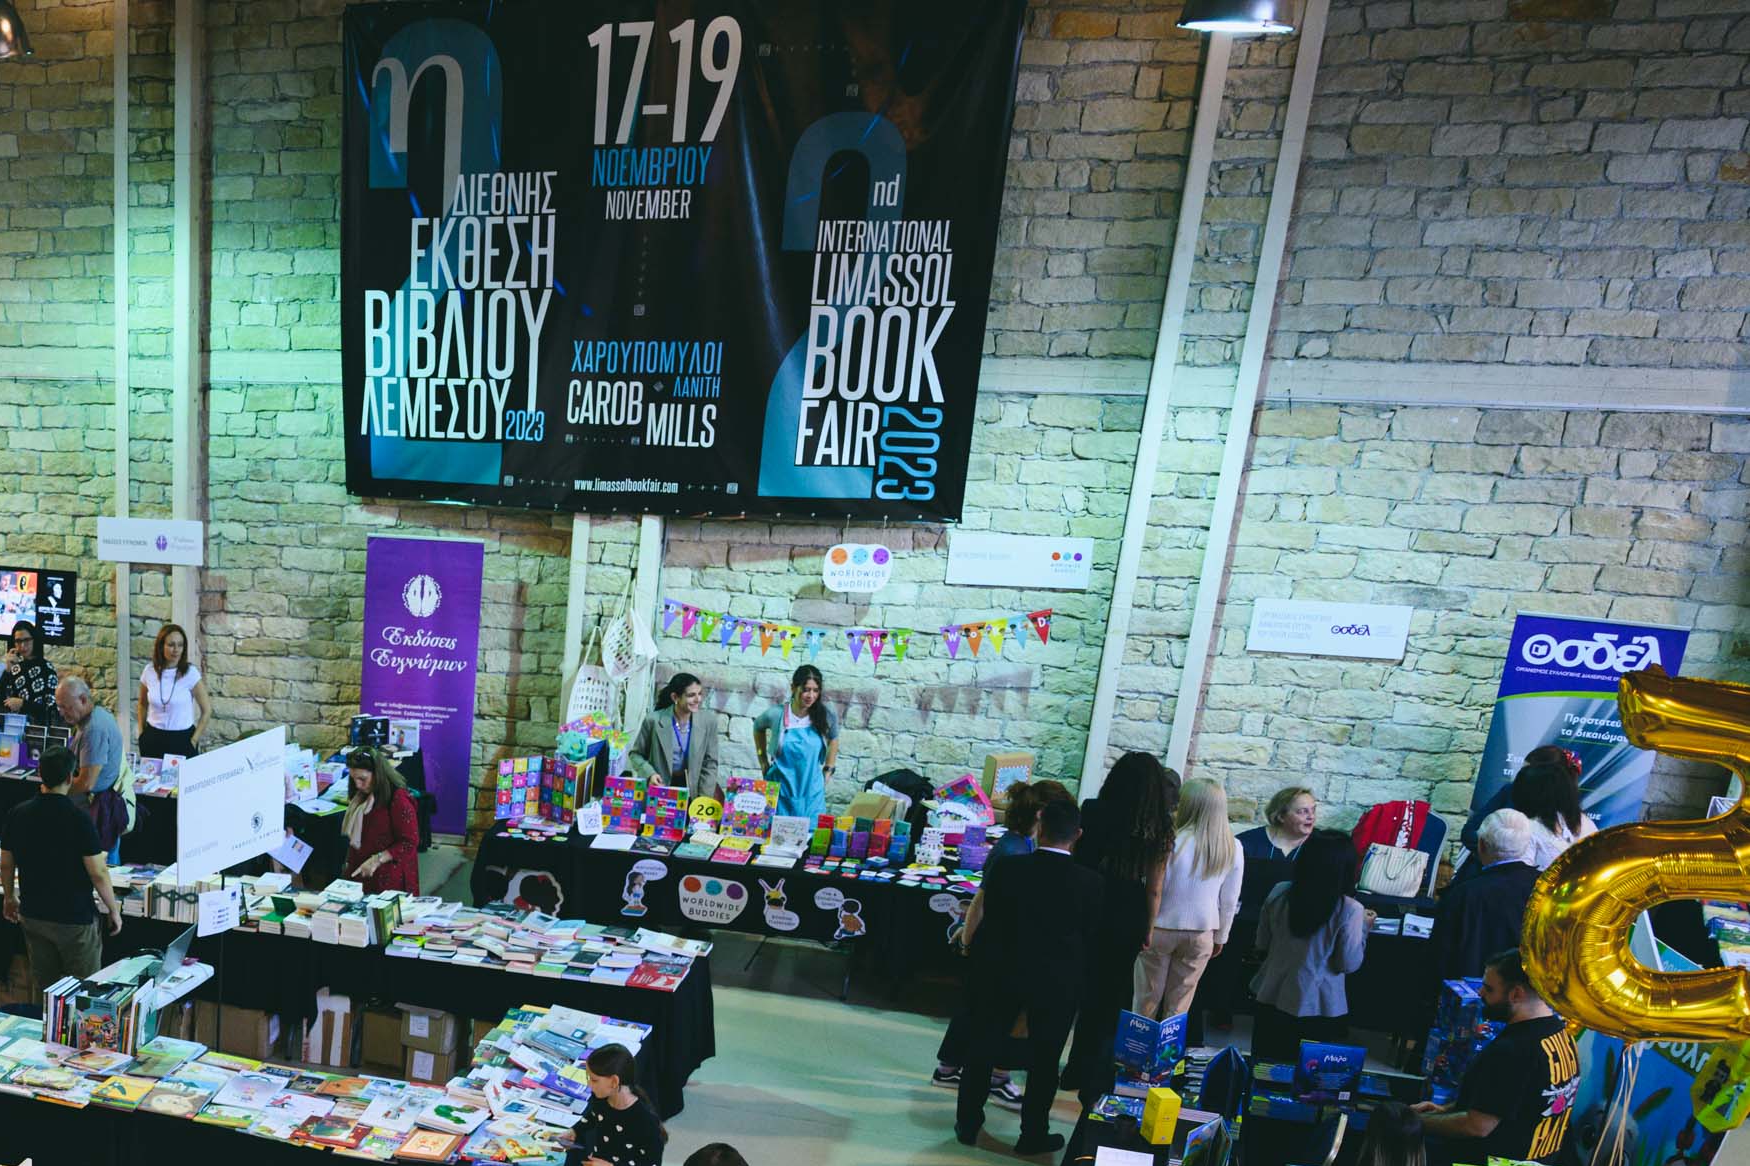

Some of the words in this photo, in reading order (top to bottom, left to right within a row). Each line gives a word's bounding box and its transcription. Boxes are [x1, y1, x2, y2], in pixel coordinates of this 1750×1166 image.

[592, 145, 711, 186] ΝΟΕΜΒΡΙΟΥ
[451, 171, 558, 216] ΔΙΕΘΝΗΣ
[605, 190, 690, 220] NOVEMBER
[410, 214, 557, 291] ΕΚΘΕΣΗ
[817, 220, 952, 253] INTERNATIONAL
[811, 254, 955, 307] LIMASSOL
[364, 289, 553, 412] ΒΙΒΛΙΟΥ
[571, 341, 722, 376] ΧΑΡΟΥΠΟΜΥΛΟΙ
[802, 306, 953, 404] BOOK
[567, 381, 642, 426] CAROB
[673, 376, 721, 398] ΛΑΝΙΤΗ
[361, 378, 511, 441] ΛΕΜΕΣΟΥ
[505, 412, 544, 442] 2023
[646, 405, 716, 448] MILLS
[795, 400, 880, 467] FAIR
[877, 407, 943, 501] 2023
[574, 479, 678, 495] www.limassolbookfair.com
[830, 569, 887, 579] WORLDWIDE
[837, 579, 878, 589] BUDDIES
[381, 626, 457, 650] Εκδόσεις
[370, 647, 467, 677] Ευγνώμων
[1561, 729, 1572, 737] τα
[682, 895, 740, 912] WORLDWIDE
[688, 907, 731, 922] BUDDIES
